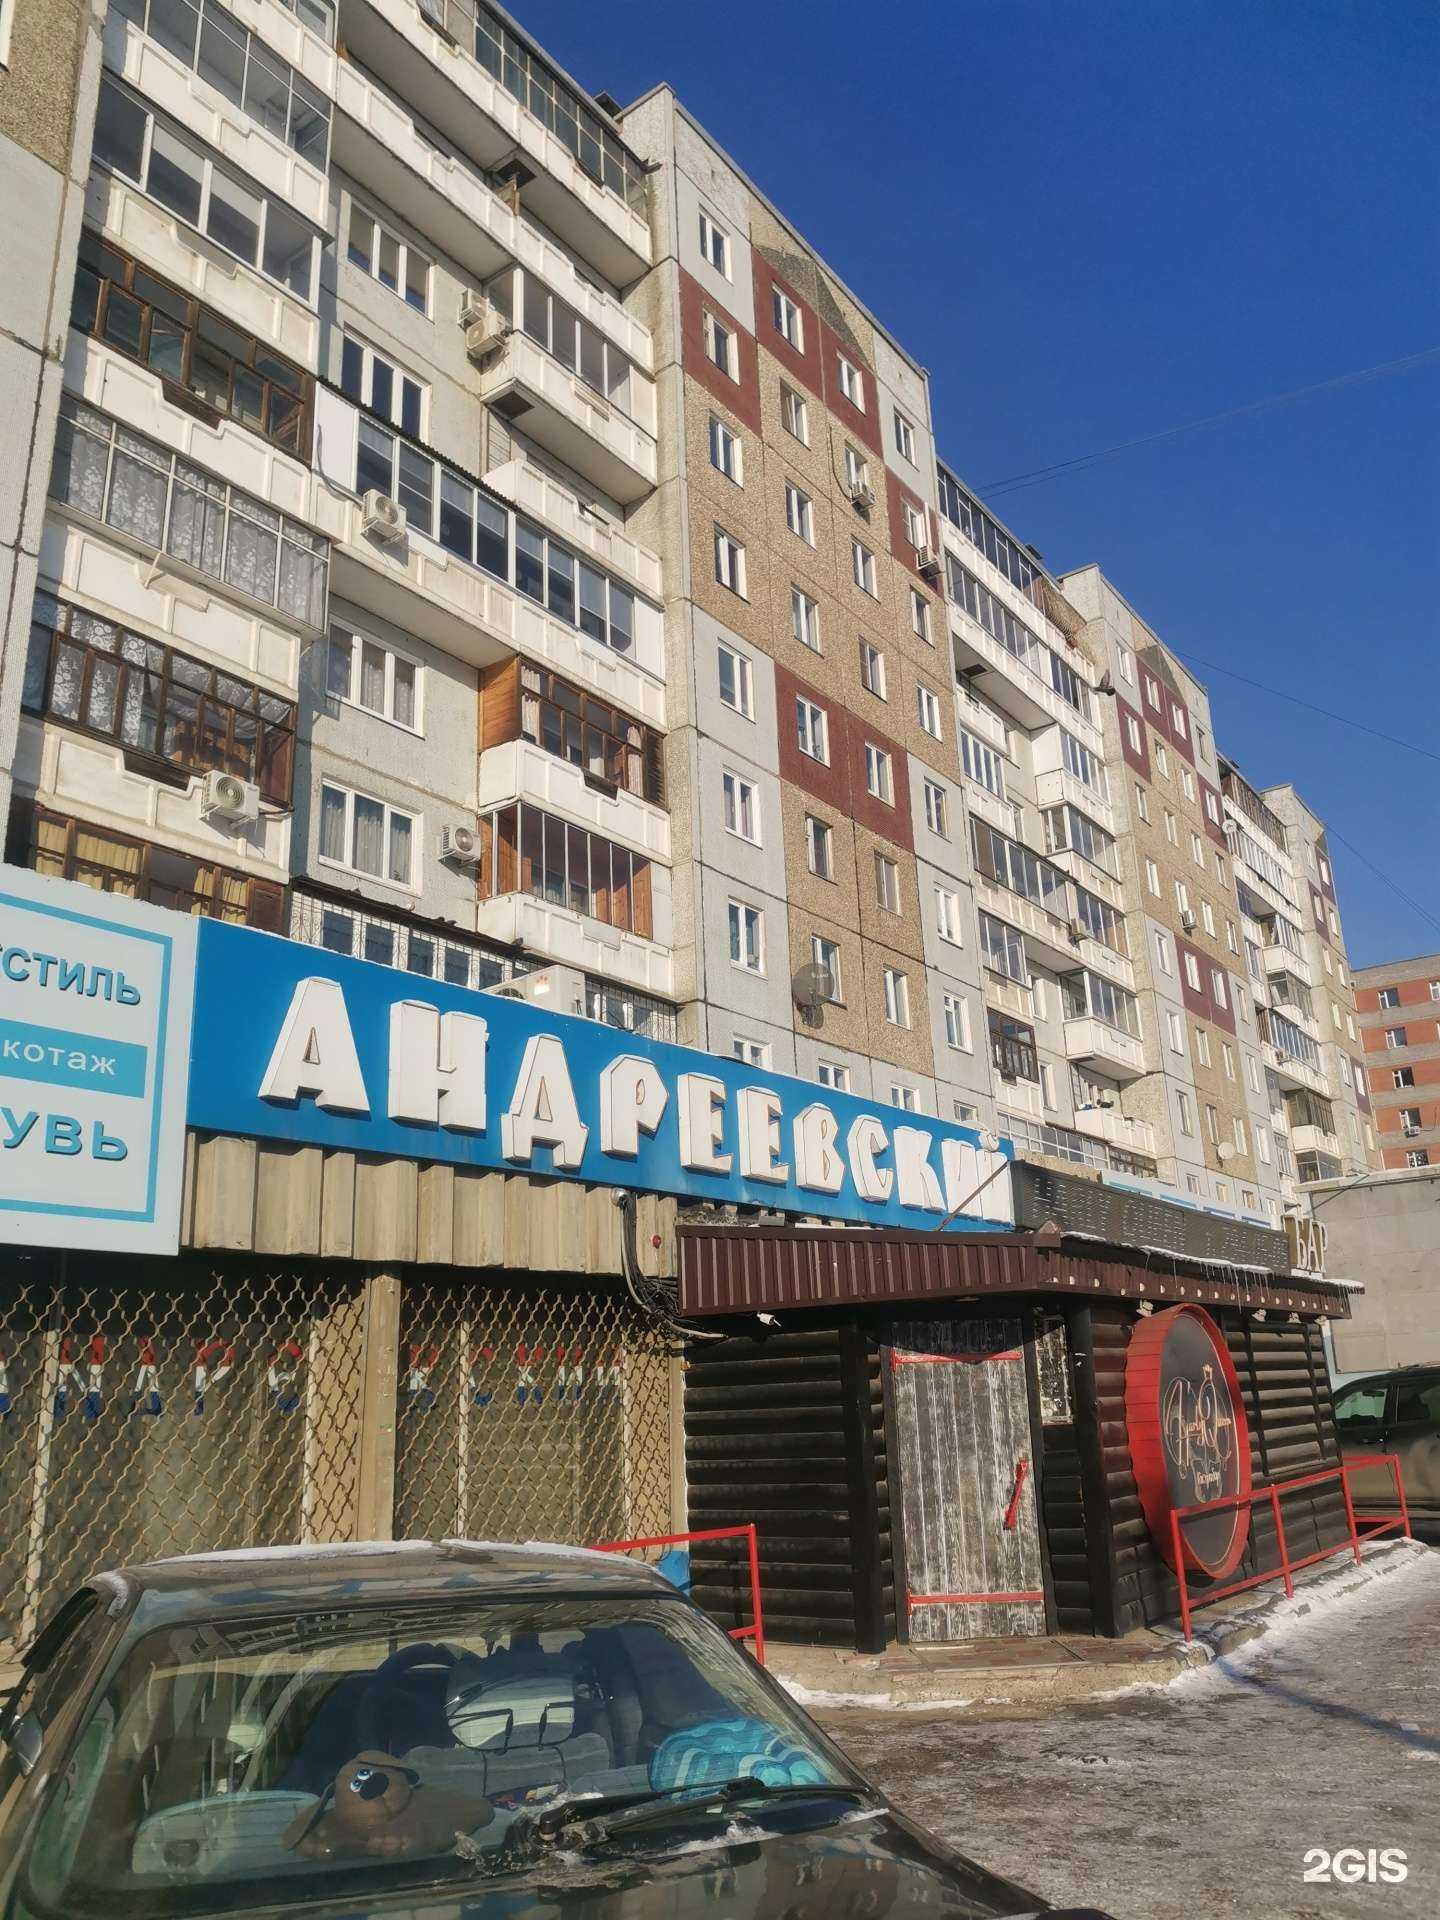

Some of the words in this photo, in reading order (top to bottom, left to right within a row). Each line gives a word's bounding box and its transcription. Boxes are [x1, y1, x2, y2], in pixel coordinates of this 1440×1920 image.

[0, 944, 141, 1006] СТИЛЬ
[3, 1039, 117, 1076] котаж
[257, 976, 1014, 1225] АНДРЕЕВСКИЙ
[1296, 1214, 1328, 1273] БАР
